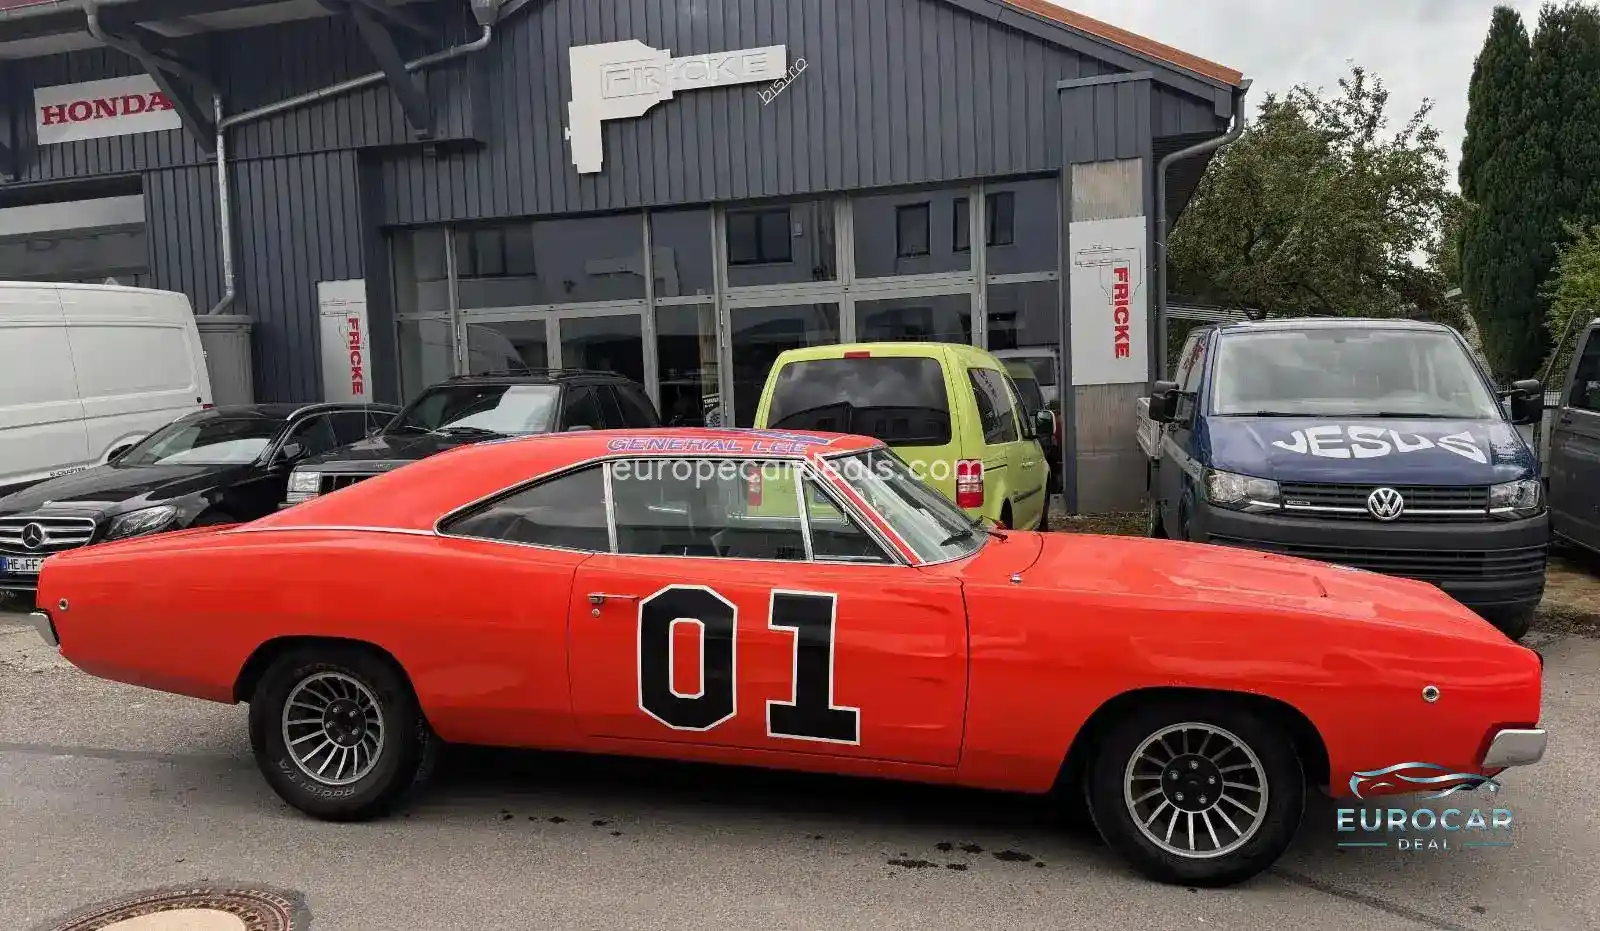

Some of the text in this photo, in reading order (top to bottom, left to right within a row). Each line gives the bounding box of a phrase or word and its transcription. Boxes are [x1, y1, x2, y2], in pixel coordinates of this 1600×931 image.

[757, 56, 808, 105] bistro
[40, 91, 176, 125] HONDA
[1114, 266, 1130, 359] FRICKE
[348, 317, 364, 395] FRICKE
[607, 437, 810, 455] GENERAL LEE
[1272, 425, 1488, 464] JESUS
[637, 584, 861, 746] 01
